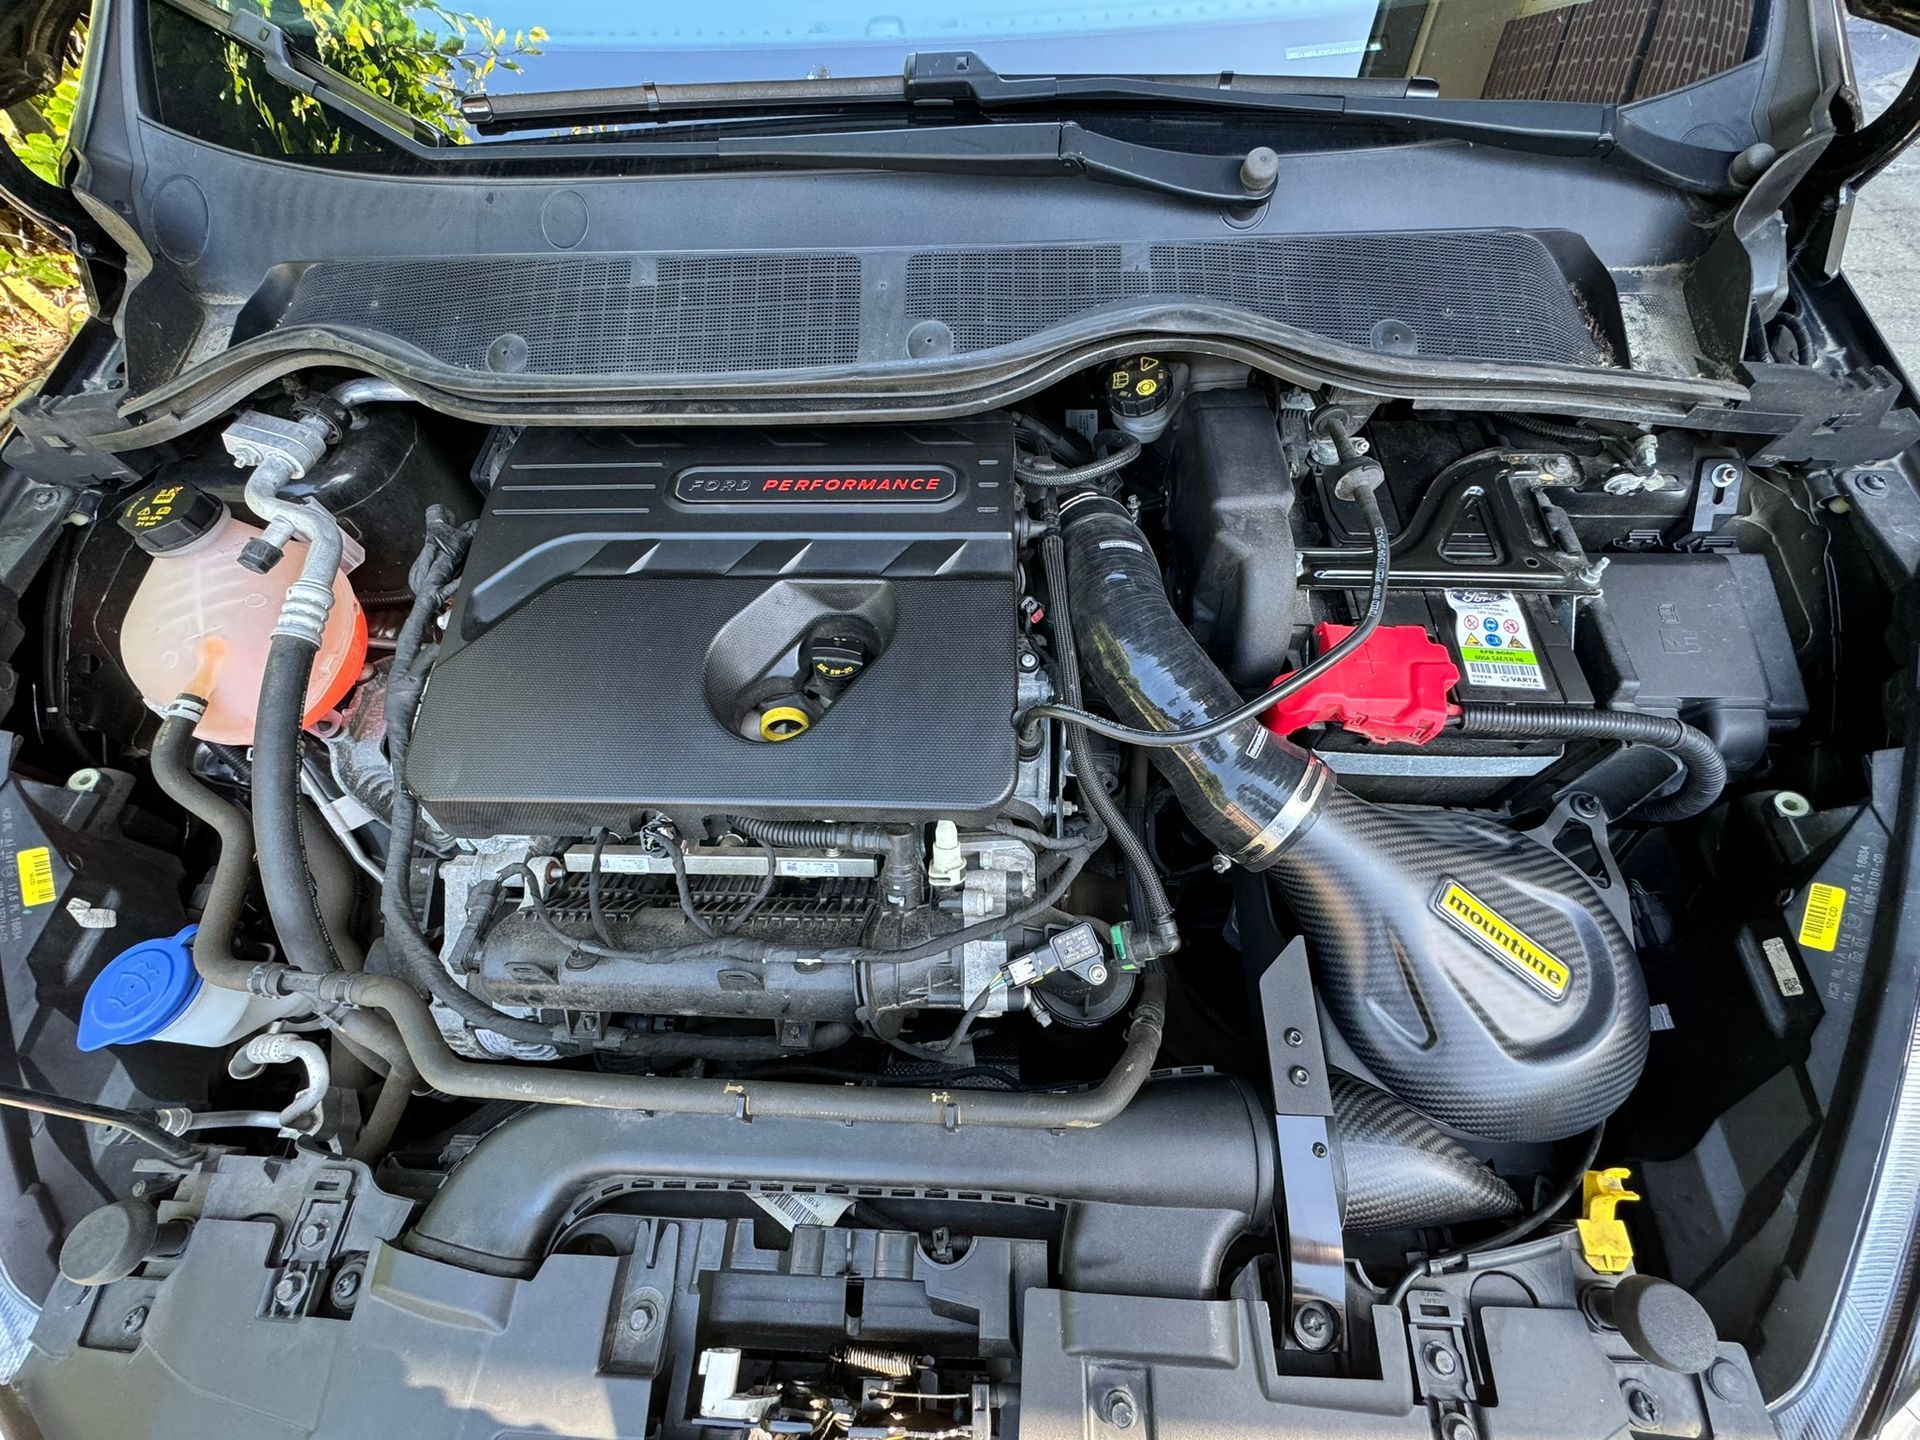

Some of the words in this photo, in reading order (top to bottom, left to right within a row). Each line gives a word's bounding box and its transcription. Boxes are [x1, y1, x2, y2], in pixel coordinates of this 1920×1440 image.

[688, 479, 752, 492] FORD
[762, 478, 942, 492] PERFORMANCE
[1510, 676, 1540, 684] VARTA
[1448, 893, 1562, 985] mountune
